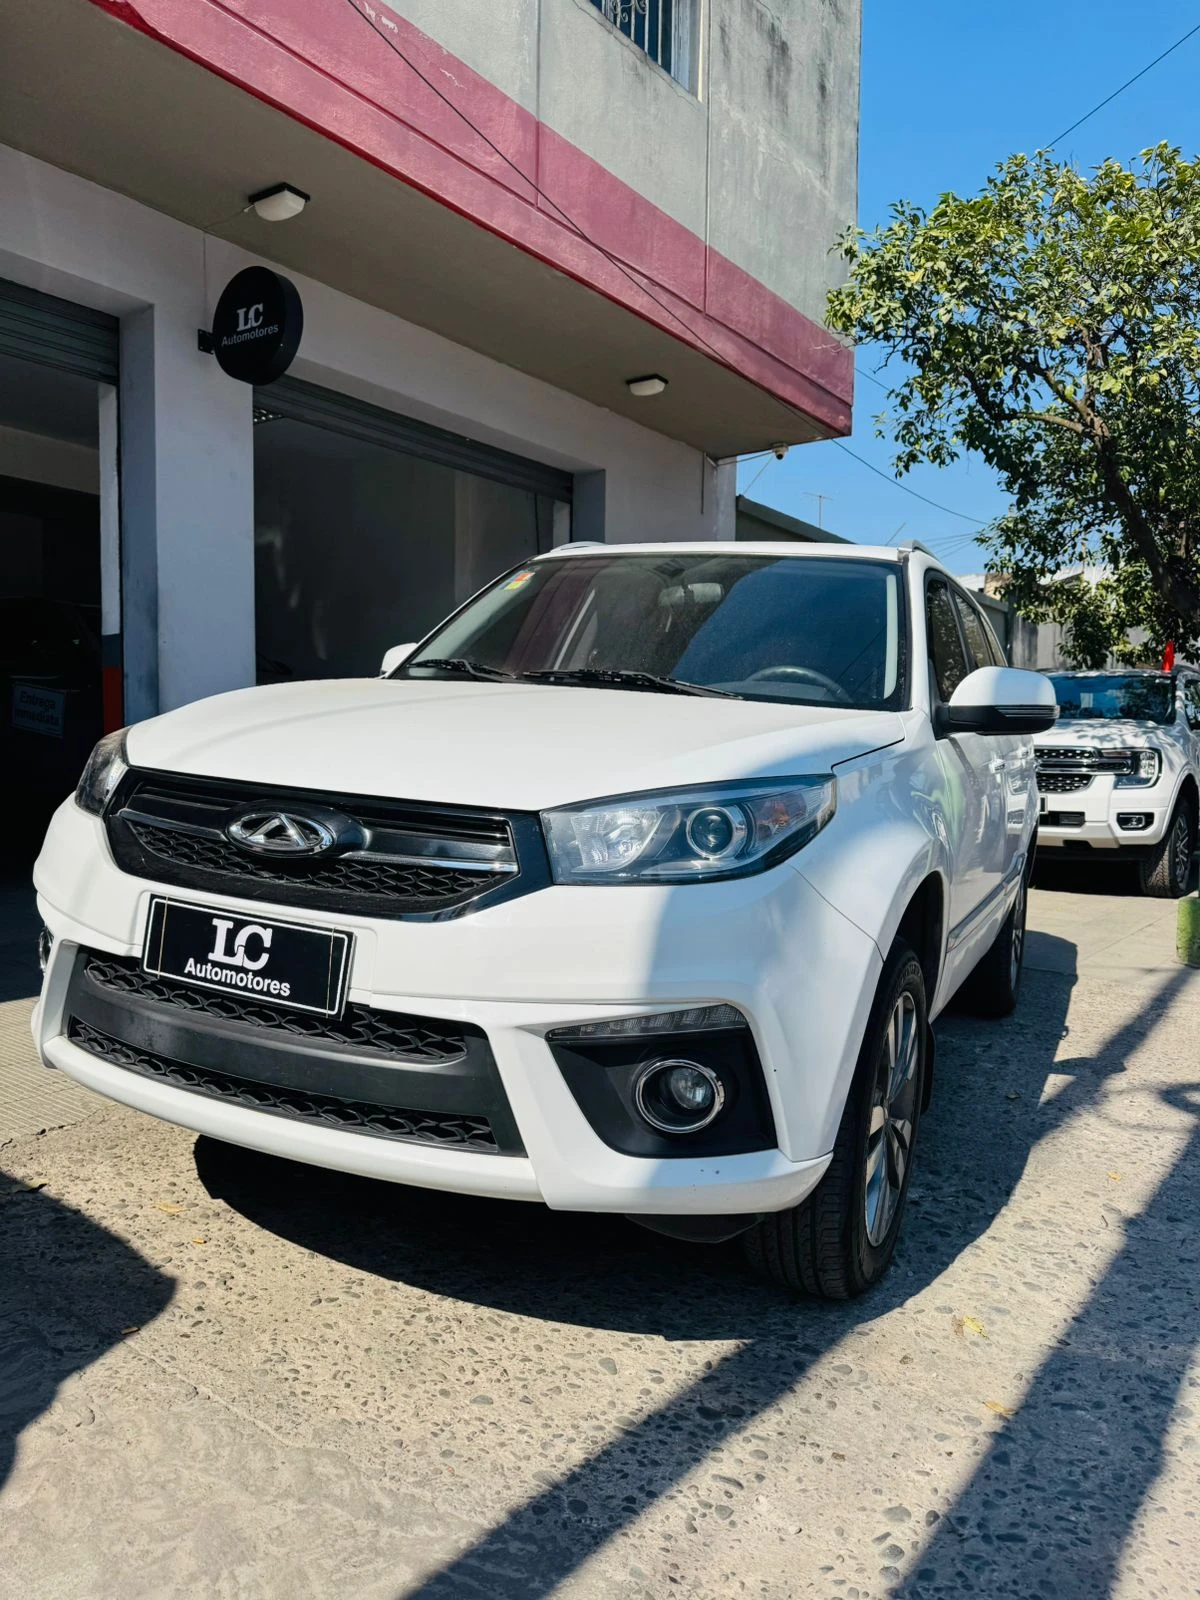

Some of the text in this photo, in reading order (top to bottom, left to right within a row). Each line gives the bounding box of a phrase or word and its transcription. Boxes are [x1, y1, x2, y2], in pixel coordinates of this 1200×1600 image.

[236, 303, 263, 331] LC
[221, 324, 279, 347] Automotores
[207, 917, 273, 971] LC
[184, 957, 291, 997] Automotores
